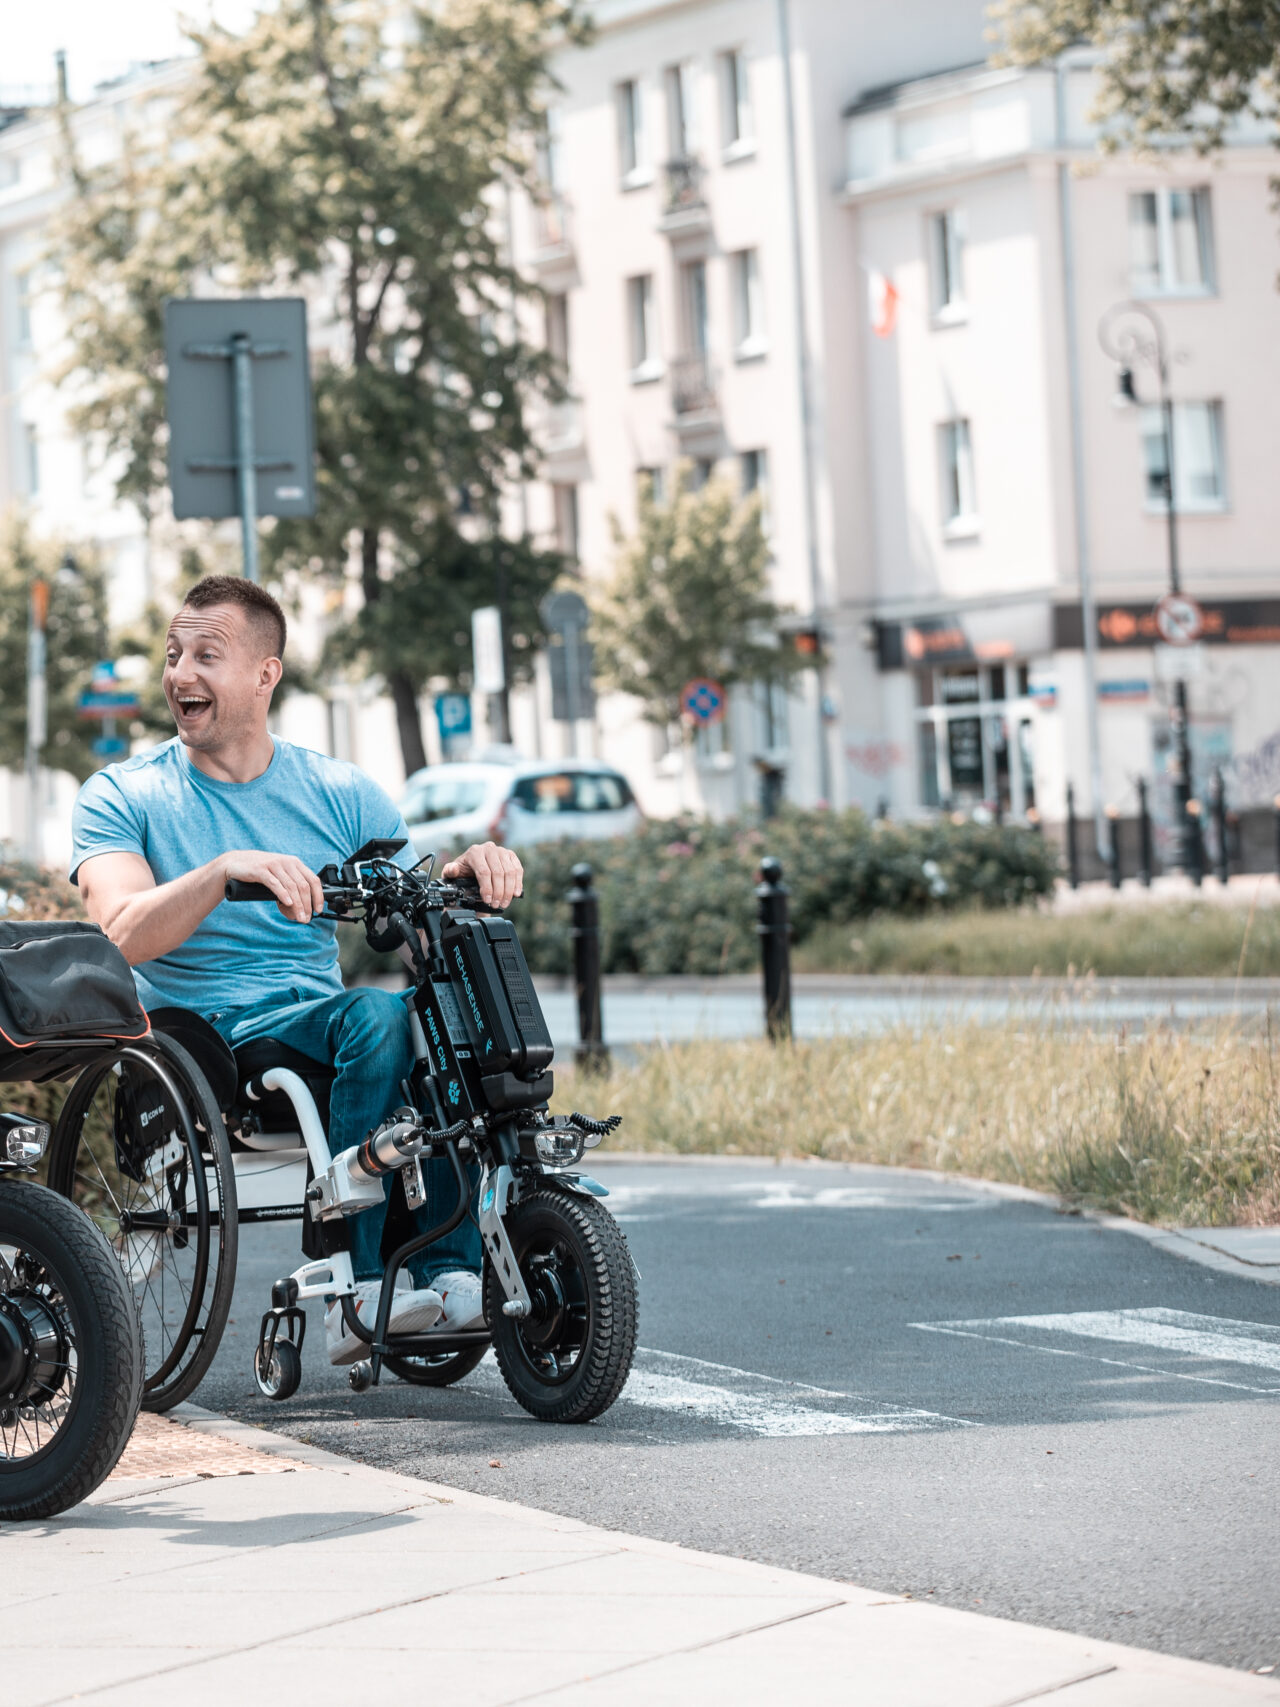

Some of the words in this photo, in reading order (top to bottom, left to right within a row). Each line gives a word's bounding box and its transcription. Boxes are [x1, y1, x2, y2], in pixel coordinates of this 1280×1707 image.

[453, 945, 484, 1033] REHASENSE
[425, 1006, 440, 1045] PAWS
[437, 1046, 448, 1072] City
